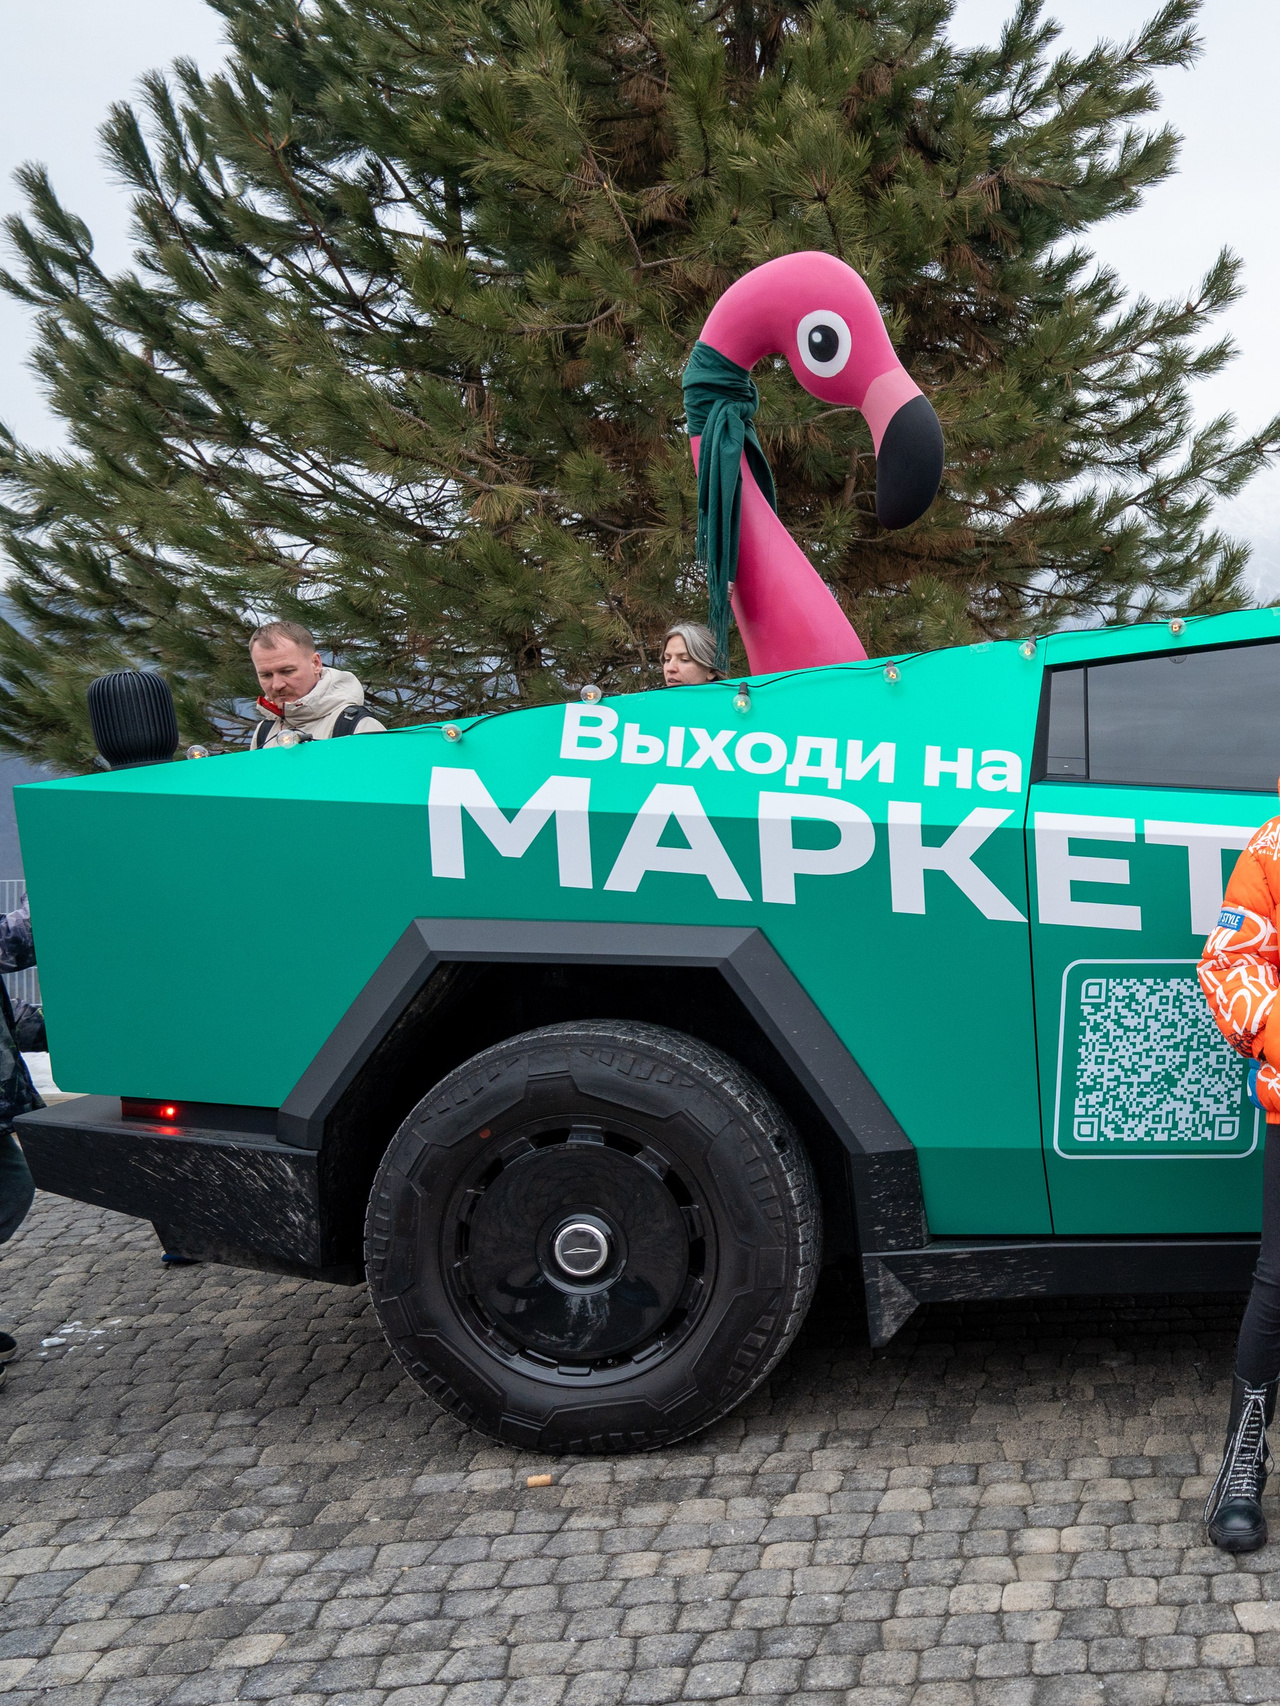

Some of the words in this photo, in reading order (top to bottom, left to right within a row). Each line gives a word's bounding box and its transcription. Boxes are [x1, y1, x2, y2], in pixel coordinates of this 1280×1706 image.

[559, 702, 897, 790] Выходи
[923, 745, 1023, 793] на
[1221, 912, 1241, 926] STYLE
